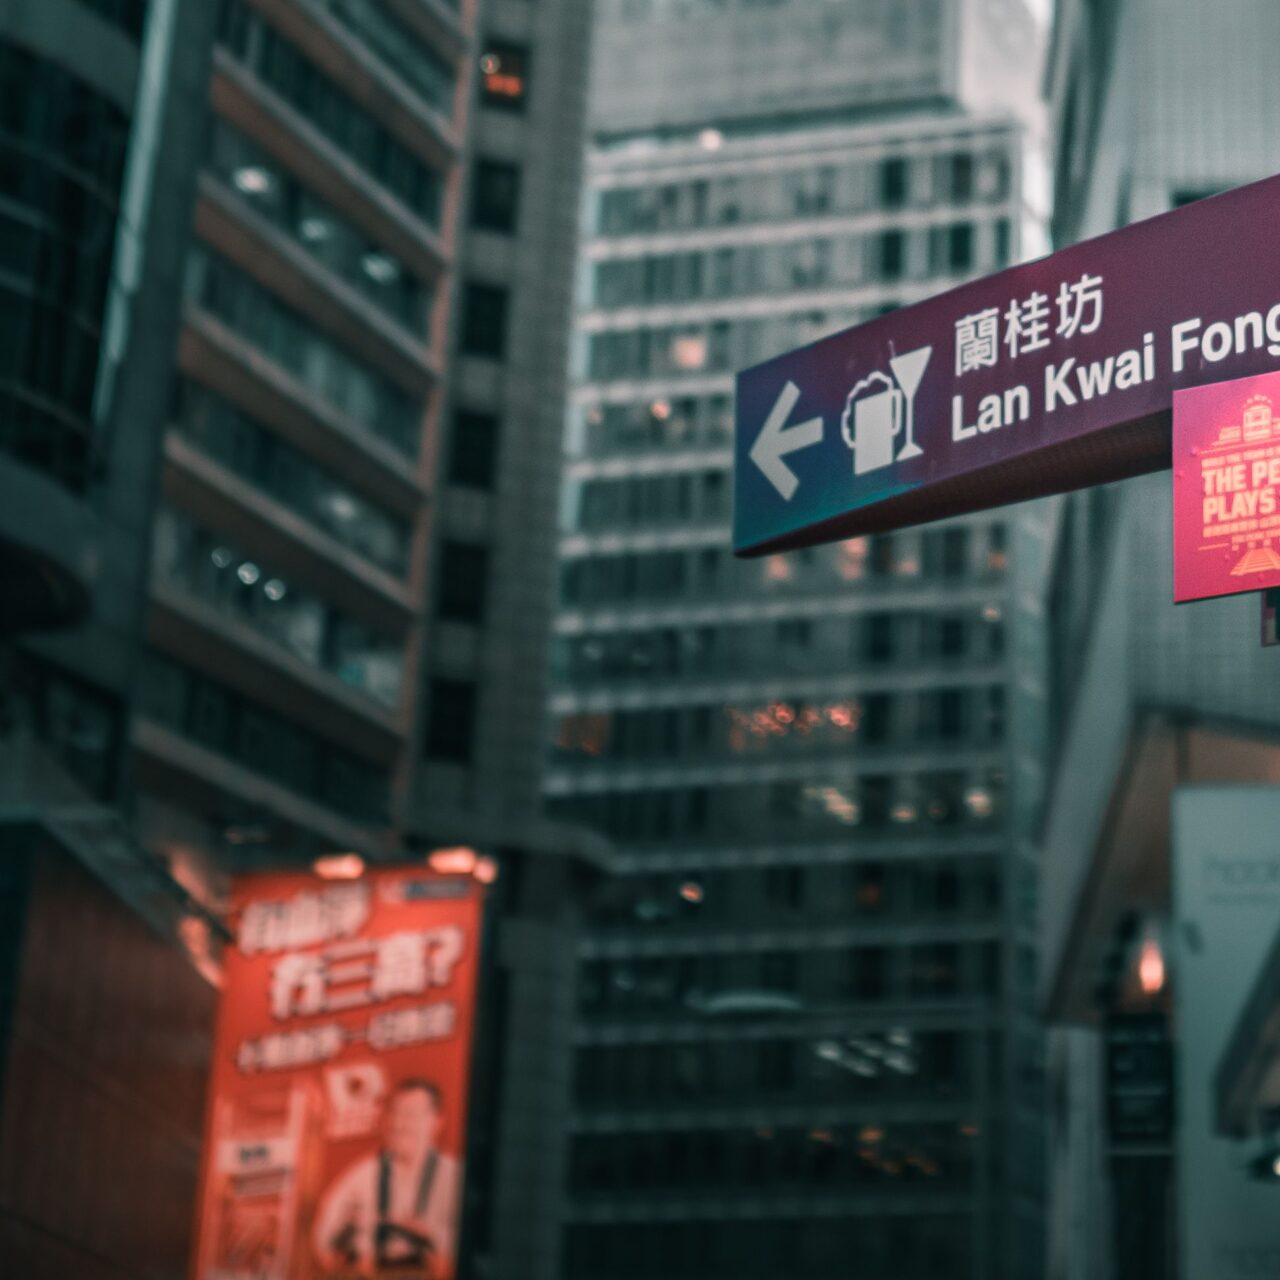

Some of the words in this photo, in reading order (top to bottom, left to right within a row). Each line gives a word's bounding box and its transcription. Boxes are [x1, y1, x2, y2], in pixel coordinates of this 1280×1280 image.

[955, 274, 1103, 377] 蘭桂坊
[952, 386, 1030, 442] Lan
[1045, 332, 1155, 412] Kwai
[1202, 463, 1247, 496] THE
[1203, 488, 1276, 525] PLAYS
